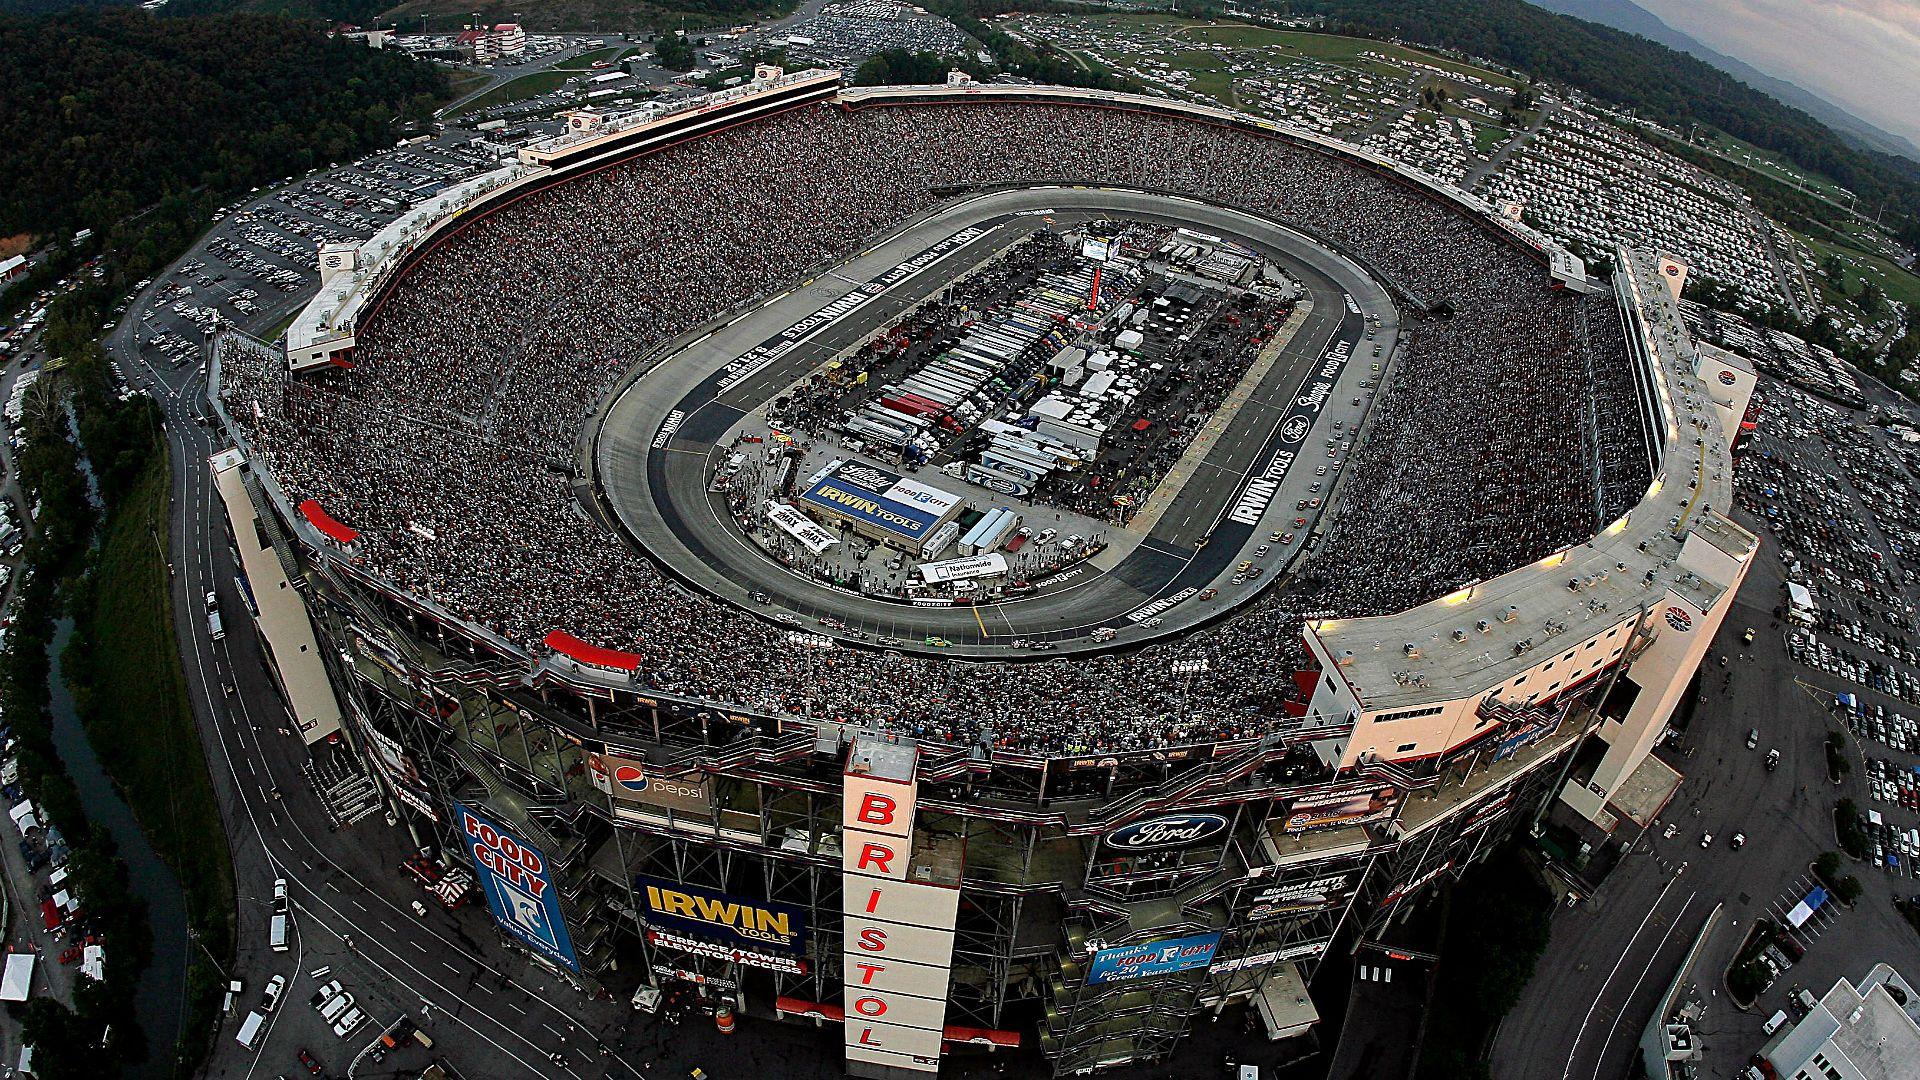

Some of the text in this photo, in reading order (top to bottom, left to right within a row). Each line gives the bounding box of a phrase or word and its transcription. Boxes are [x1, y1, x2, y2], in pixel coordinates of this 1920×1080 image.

[911, 251, 940, 268] FOOD
[882, 269, 906, 284] CITY
[782, 291, 869, 338] IRWIN TOOLS
[1321, 339, 1351, 379] FOOD CITY
[662, 410, 685, 433] IRWIN
[1284, 421, 1306, 440] Ford
[893, 486, 950, 509] FOOD CITY
[1230, 450, 1294, 526] IRWIN TOOLS
[816, 485, 879, 514] IRWIN
[877, 509, 920, 531] TOOLS
[949, 560, 992, 572] Nationwide
[1036, 568, 1084, 589] FOOD CITY
[1126, 587, 1198, 622] IRWIN TOOLS
[653, 782, 703, 799] pepsi
[464, 812, 542, 874] FOOD
[1128, 819, 1205, 846] Ford
[474, 843, 548, 898] CITY
[1263, 875, 1347, 896] Richard PETTY
[646, 885, 790, 935] IRWIN
[854, 791, 897, 1047] BRISTOL
[738, 926, 791, 943] TOOLS
[654, 939, 802, 975] ELEVATOR ACCESS
[656, 932, 797, 967] TERRACE/TOWER
[1099, 945, 1149, 962] Thanks
[1116, 943, 1215, 967] FOOD CITY
[1106, 972, 1138, 983] Great
[1122, 966, 1137, 975] 20
